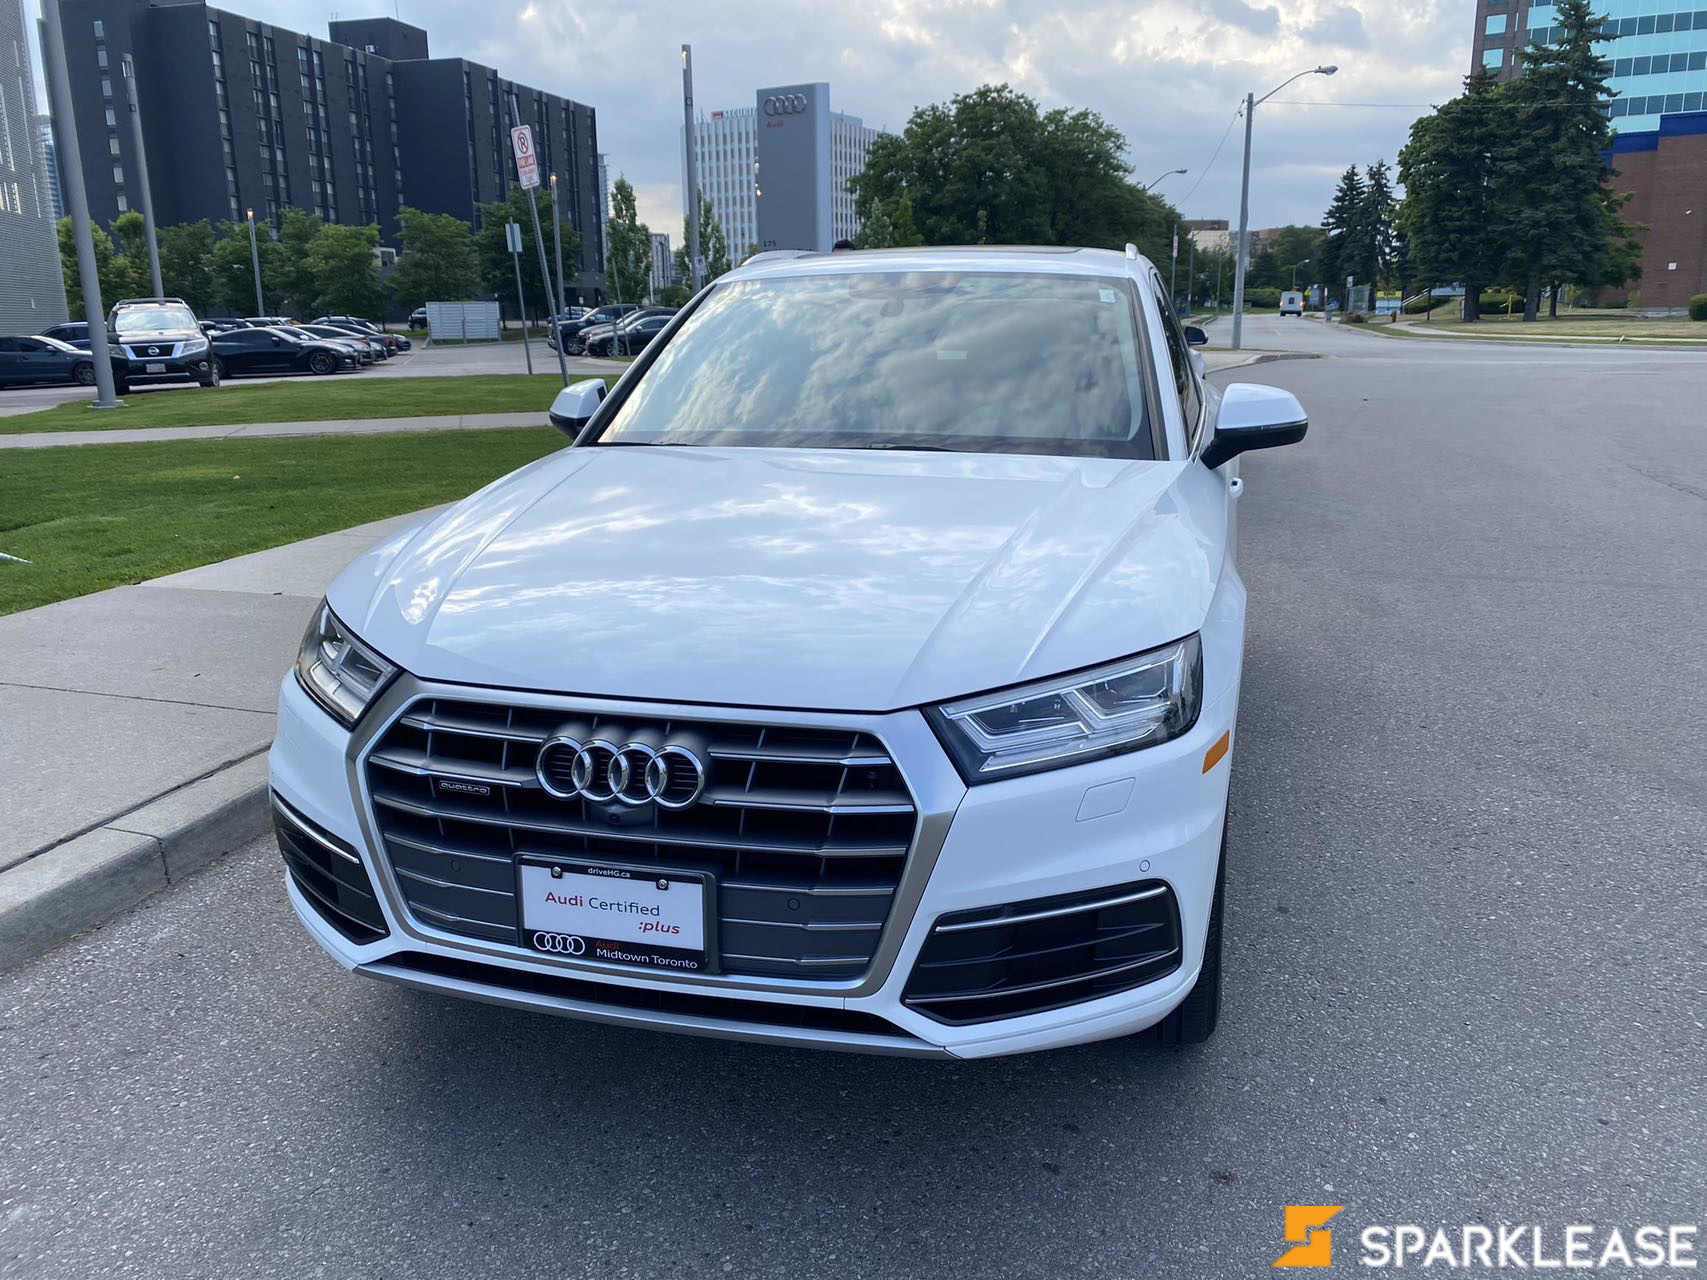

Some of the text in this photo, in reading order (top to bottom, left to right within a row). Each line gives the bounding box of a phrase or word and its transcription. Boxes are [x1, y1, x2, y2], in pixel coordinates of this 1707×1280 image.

[587, 867, 631, 878] driveHG.ca
[545, 892, 660, 917] Audi Certified
[638, 921, 681, 935] :plus
[596, 948, 698, 969] Midtown Toronto
